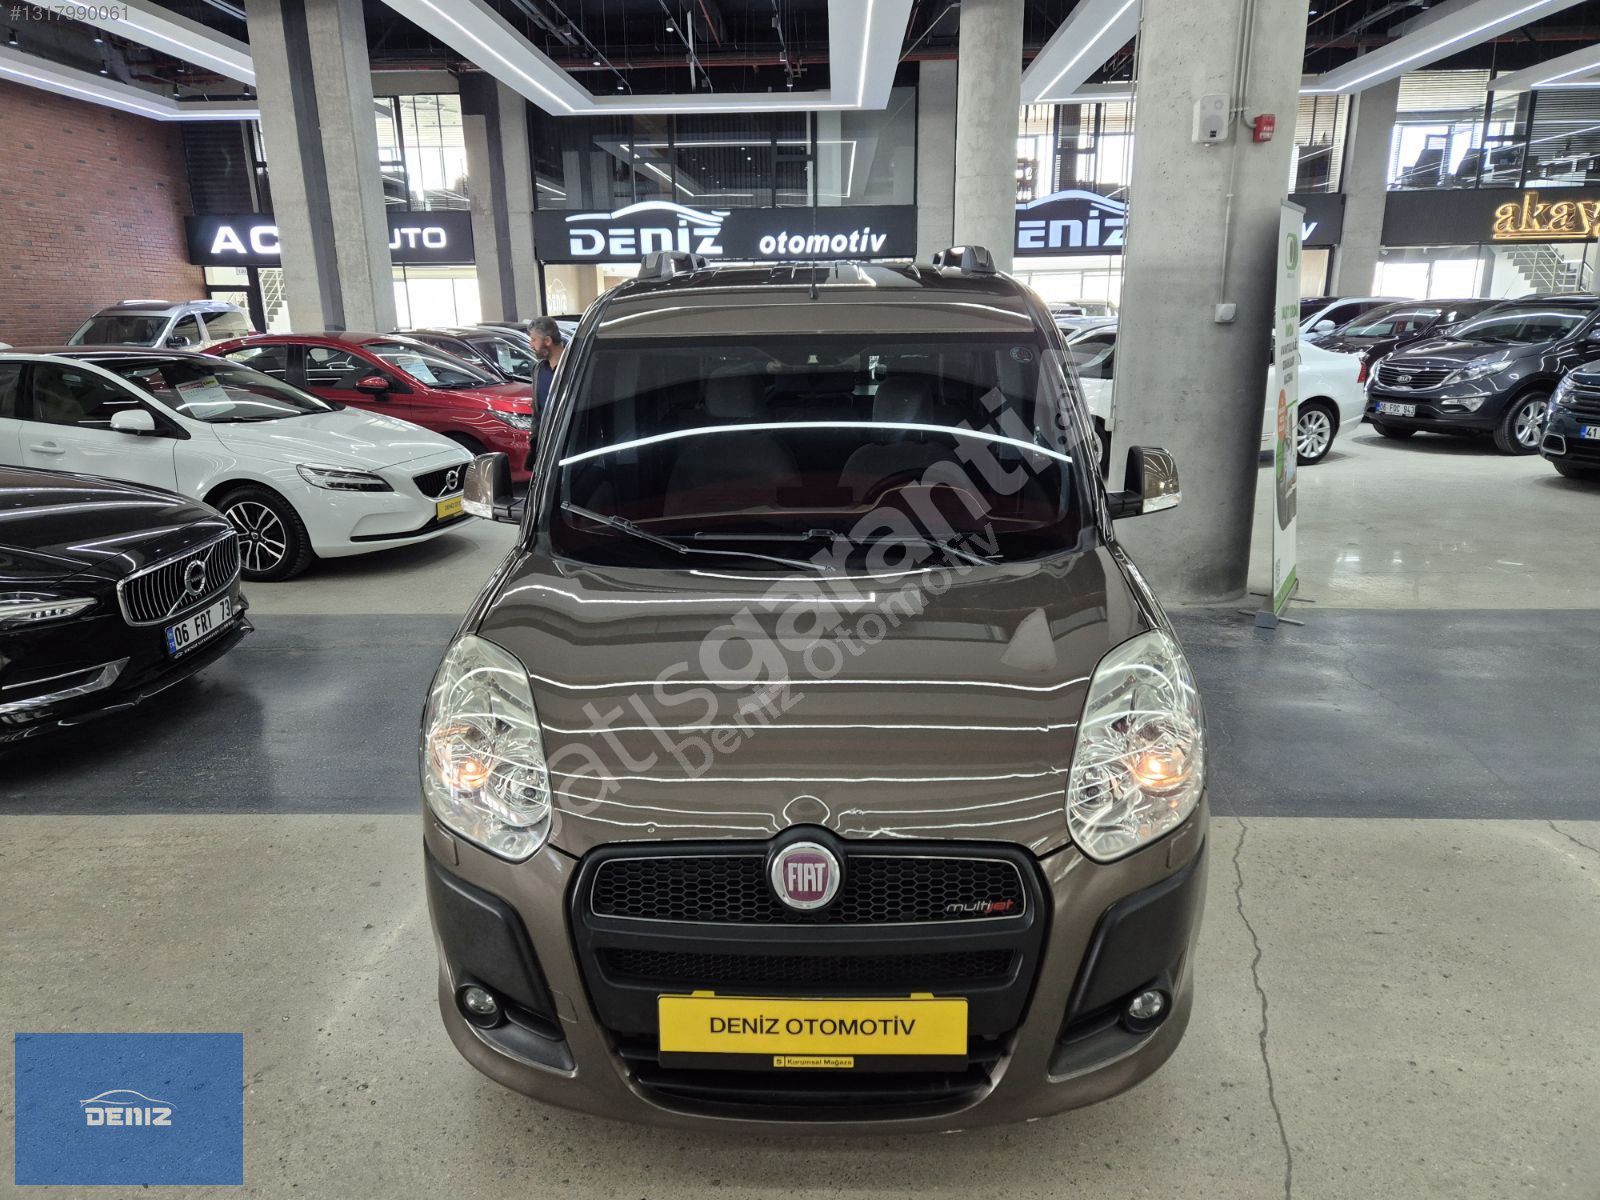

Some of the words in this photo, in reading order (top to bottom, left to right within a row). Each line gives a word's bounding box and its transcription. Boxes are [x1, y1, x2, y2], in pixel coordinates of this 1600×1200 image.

[759, 227, 886, 254] otomotiv
[174, 623, 190, 647] 06
[194, 609, 213, 636] FRT
[219, 598, 231, 621] 73
[787, 862, 826, 893] FIAT
[946, 898, 1014, 914] multijet
[709, 1013, 780, 1035] DENİZ
[785, 1014, 916, 1037] OTOMOTİV
